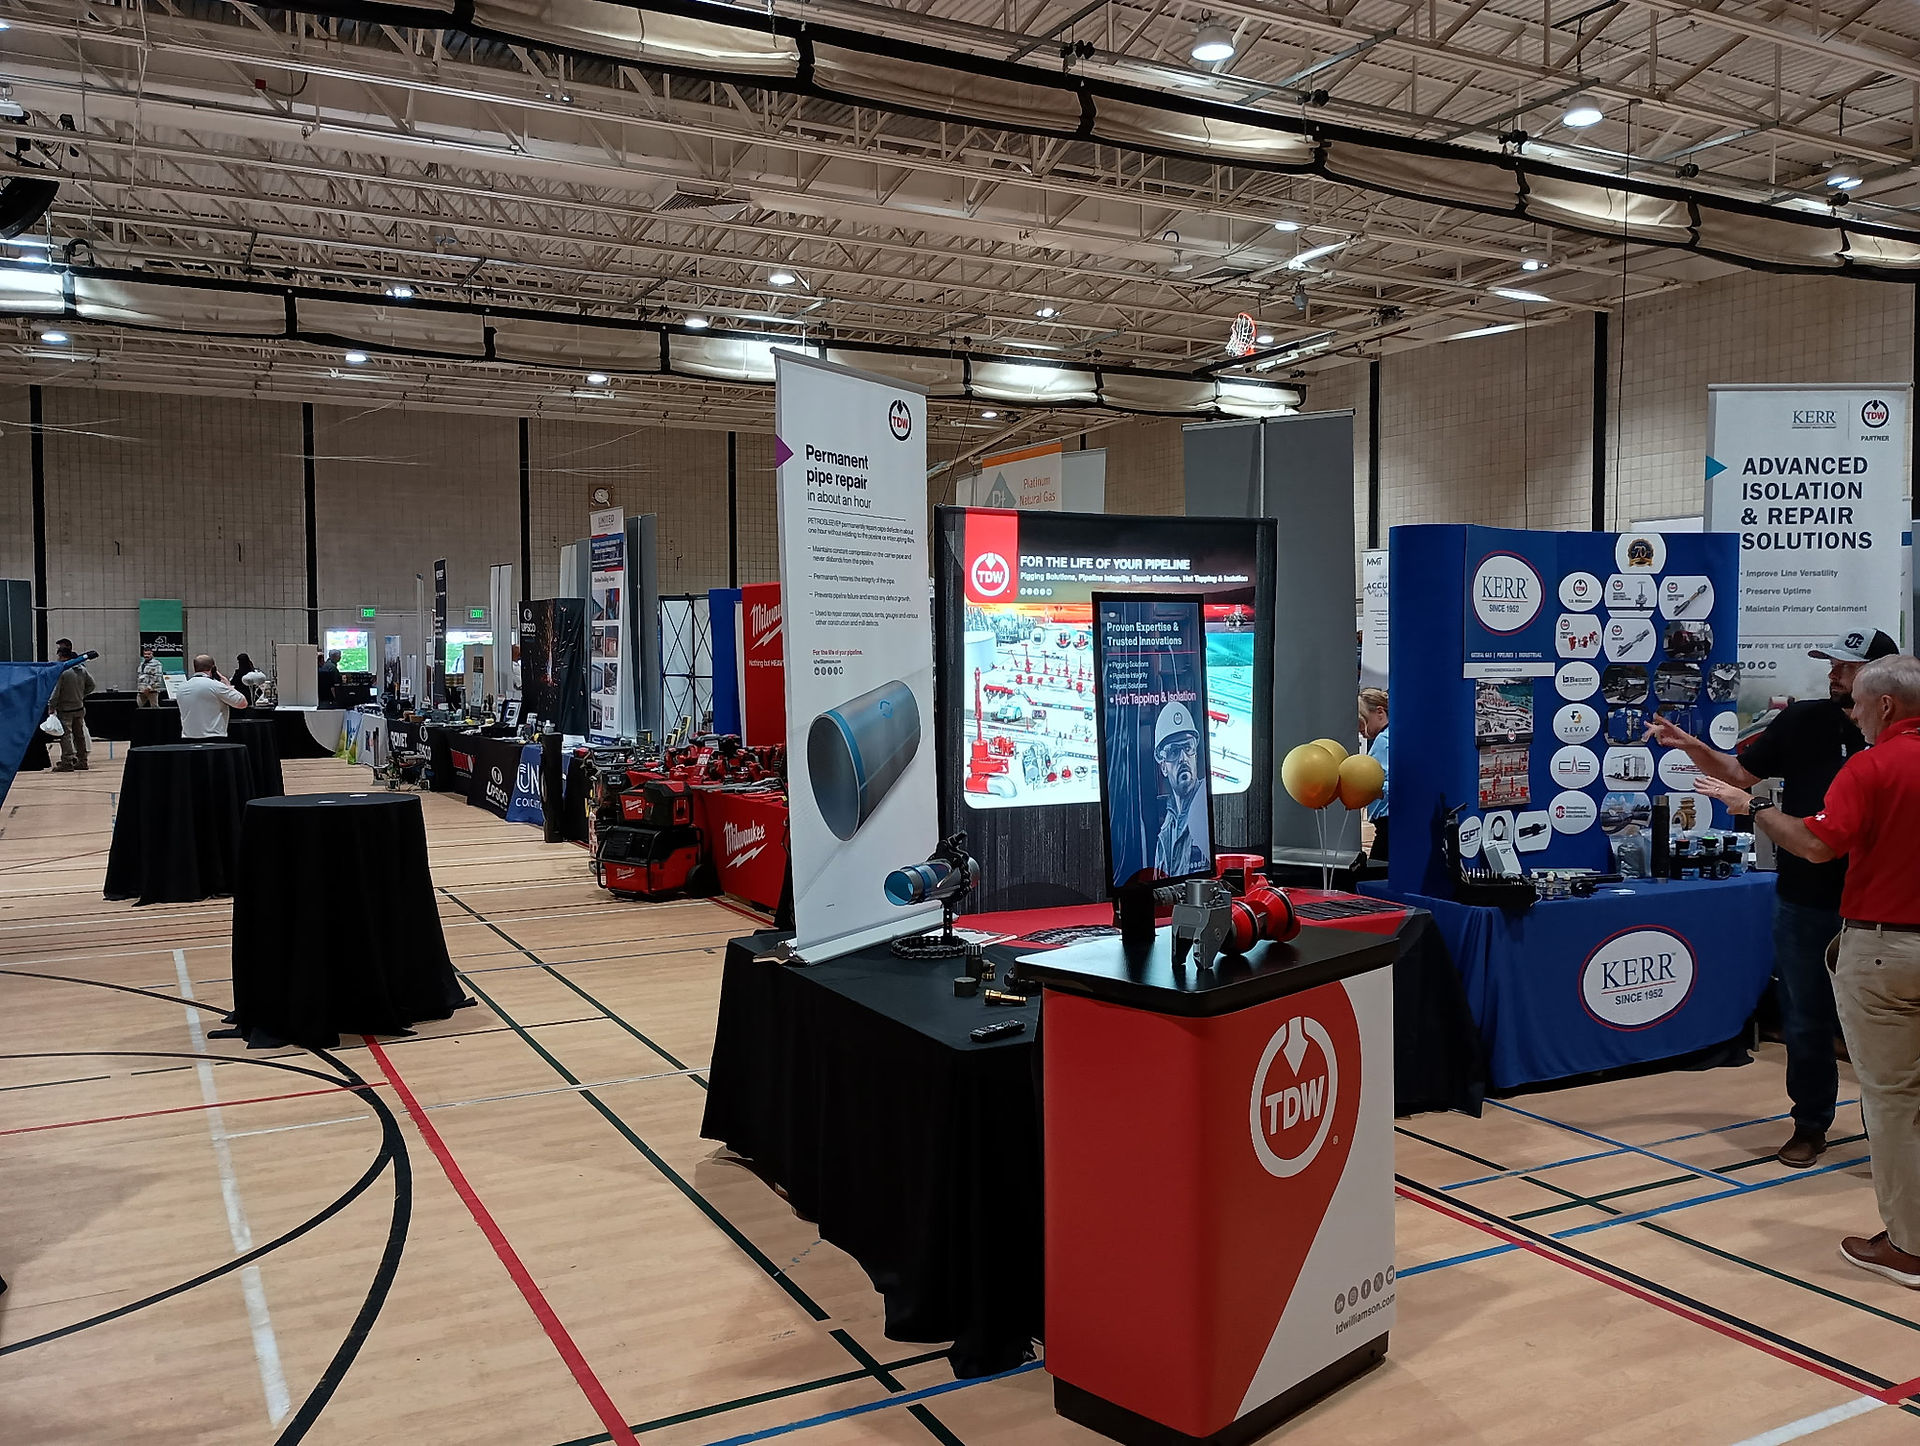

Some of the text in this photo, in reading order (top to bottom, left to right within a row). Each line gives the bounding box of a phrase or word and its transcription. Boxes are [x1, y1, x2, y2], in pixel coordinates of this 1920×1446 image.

[892, 416, 909, 430] TDW
[1793, 410, 1836, 423] KERR
[1866, 412, 1885, 420] TDW
[806, 444, 869, 470] Permanent
[1742, 456, 1868, 475] ADVANCED
[806, 467, 868, 492] pipe repair
[1023, 476, 1051, 490] Platinum
[1019, 491, 1056, 506] Natural Gas
[1742, 482, 1863, 500] ISOLATION
[807, 490, 872, 509] in about an hour
[1741, 507, 1854, 525] & REPAIR
[1741, 531, 1872, 550] SOLUTIONS
[1020, 556, 1191, 570] FOR THE LIFE OF YOUR PIPELINE
[978, 570, 1004, 585] TDW
[1020, 572, 1045, 582] Pigging
[1046, 572, 1078, 582] Solutions,
[1078, 573, 1104, 582] Pipeline
[1746, 569, 1838, 579] Improve Line Versatility
[1481, 576, 1528, 599] KERR
[1746, 586, 1812, 596] Preserve Uptime
[1488, 604, 1520, 613] SINCE 1952
[1745, 604, 1868, 614] Maintain Primary Containment
[1106, 622, 1179, 634] Proven Expertise &
[1107, 636, 1182, 646] Trusted Innovations
[1112, 661, 1129, 669] Pigging
[1115, 690, 1196, 707] Hot Tapping & Isolation
[1564, 725, 1590, 734] ZEVAC
[486, 781, 508, 806] UPSCO
[723, 820, 766, 856] Milwaukee
[1460, 826, 1480, 842] GPT
[1601, 953, 1676, 990] KERR
[1615, 989, 1663, 1005] SINCE 1952
[1265, 1074, 1325, 1136] TDW
[1335, 1292, 1396, 1336] tdwilliamson.com
